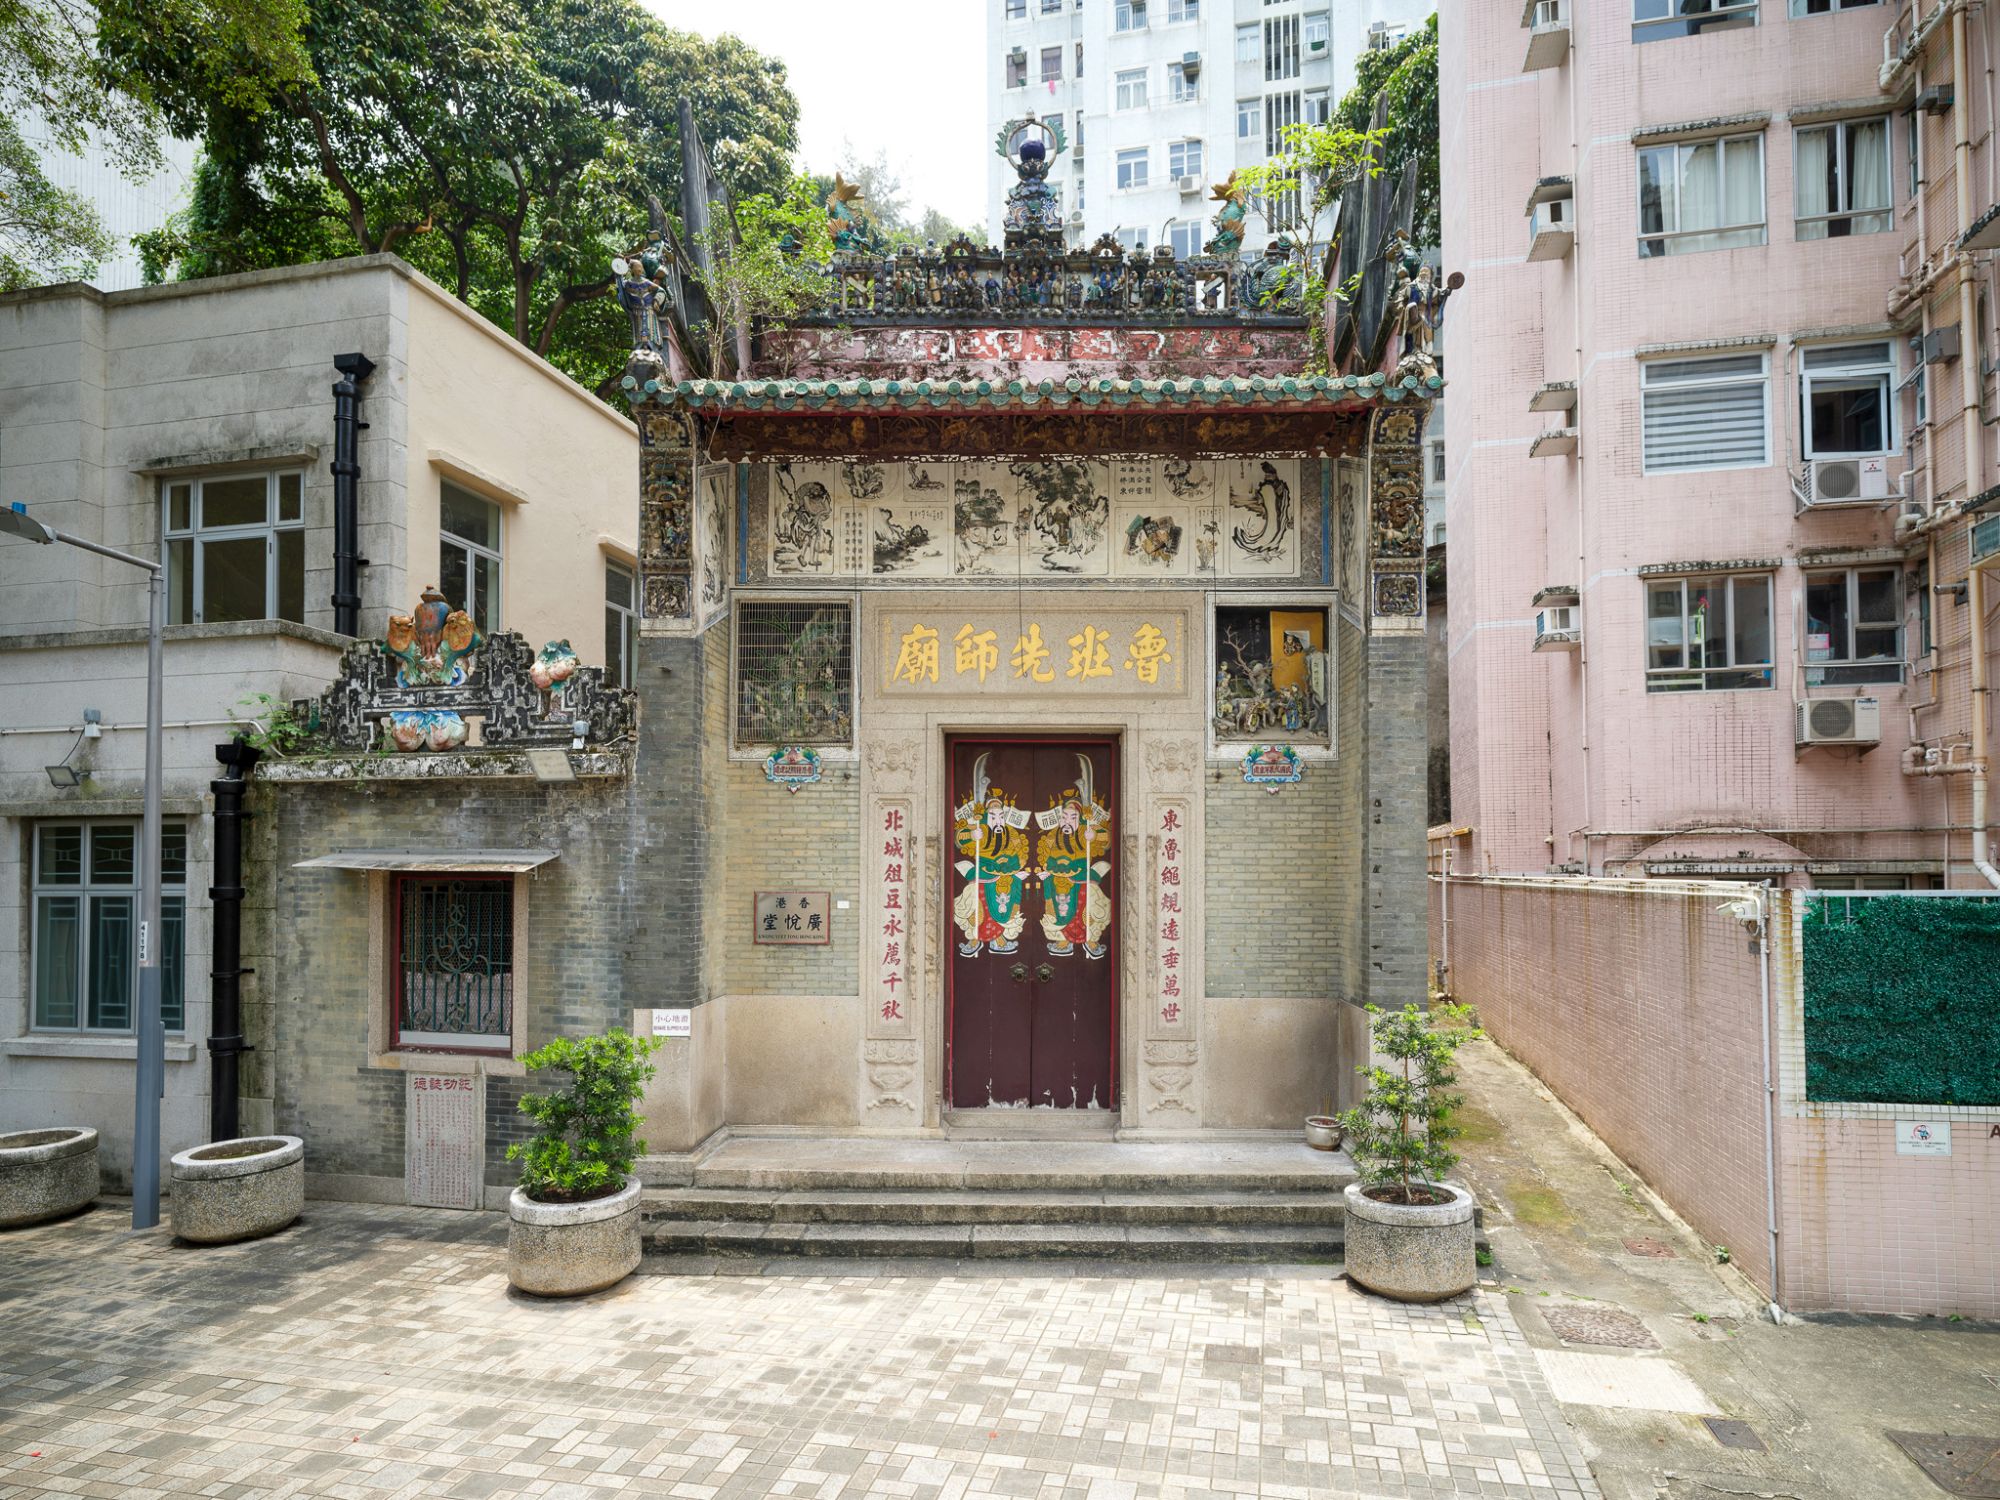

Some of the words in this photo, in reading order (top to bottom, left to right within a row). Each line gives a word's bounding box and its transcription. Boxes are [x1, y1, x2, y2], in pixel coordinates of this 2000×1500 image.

[893, 623, 1172, 684] 魯班先師廟
[776, 897, 810, 909] 香港
